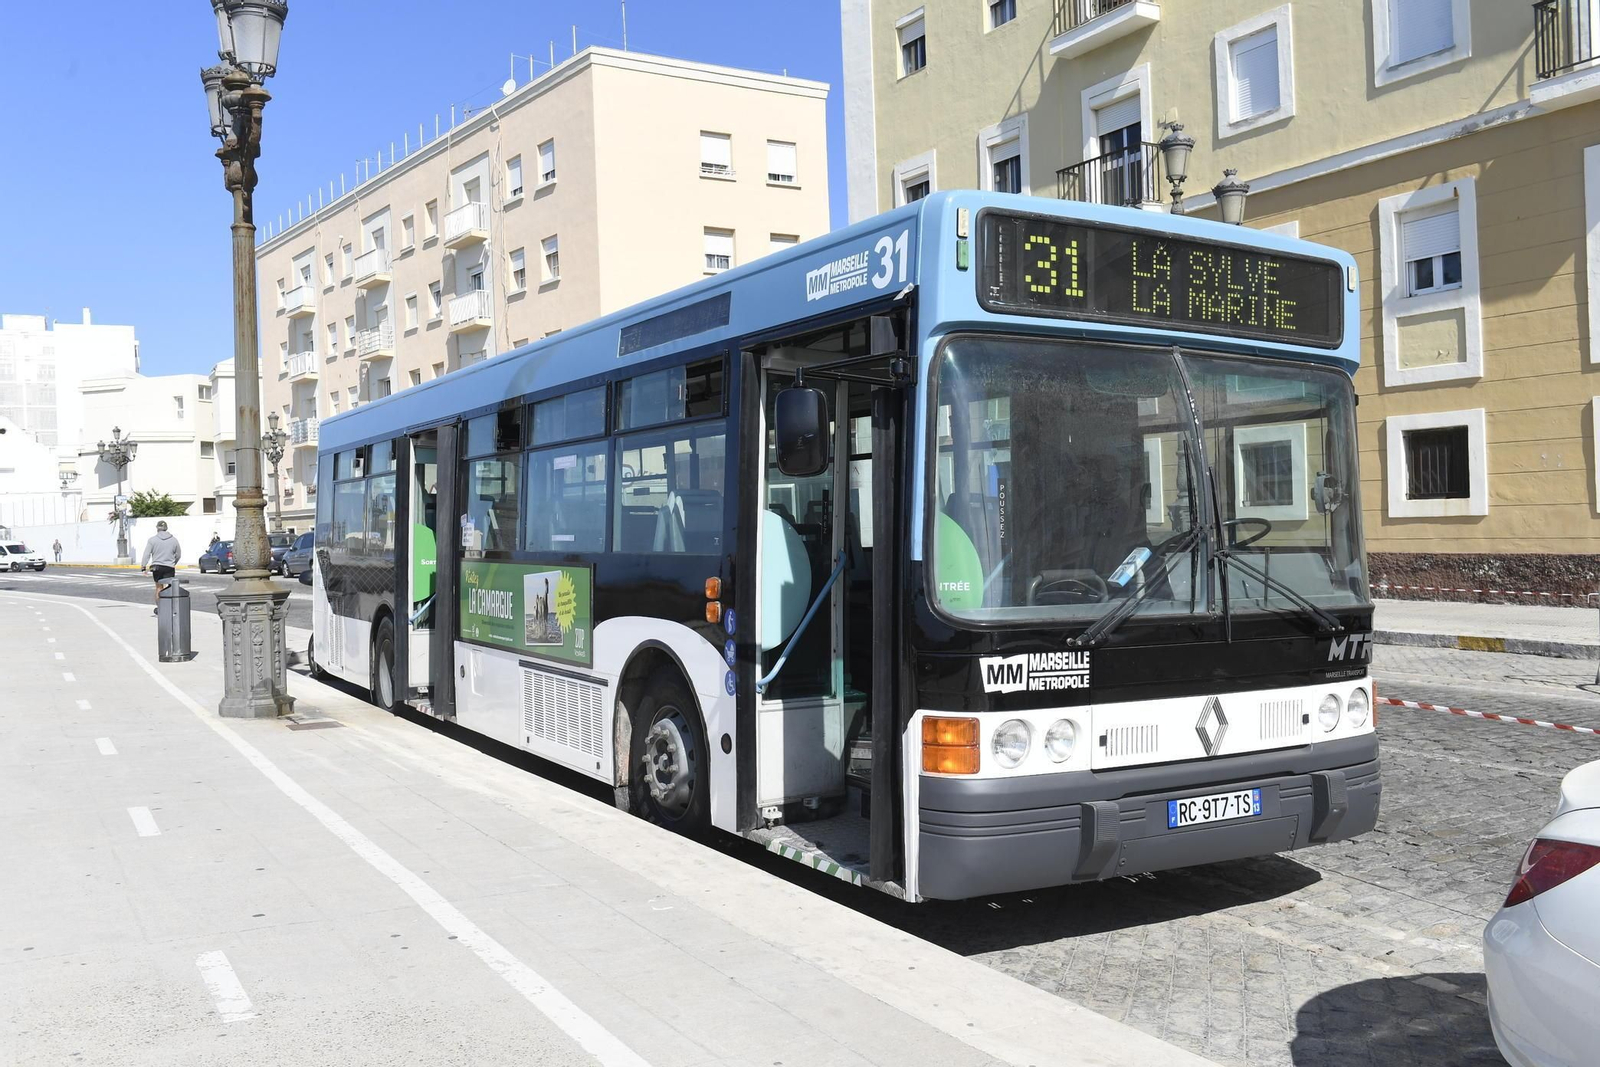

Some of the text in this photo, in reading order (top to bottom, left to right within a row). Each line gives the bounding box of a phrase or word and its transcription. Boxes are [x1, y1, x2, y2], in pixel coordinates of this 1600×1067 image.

[831, 250, 869, 277] MARSEILLE
[871, 229, 909, 290] 31
[1024, 235, 1084, 297] 31
[1132, 241, 1280, 295] LA SYLVE
[808, 271, 828, 295] MM
[829, 273, 868, 295] METROPOLE
[1132, 280, 1297, 330] LA MARINE
[468, 587, 513, 620] LA CAMARGUE
[1029, 651, 1090, 671] MARSEILLE
[987, 663, 1023, 685] MM
[1029, 675, 1090, 691] METROPOLE
[1253, 803, 1261, 812] 13
